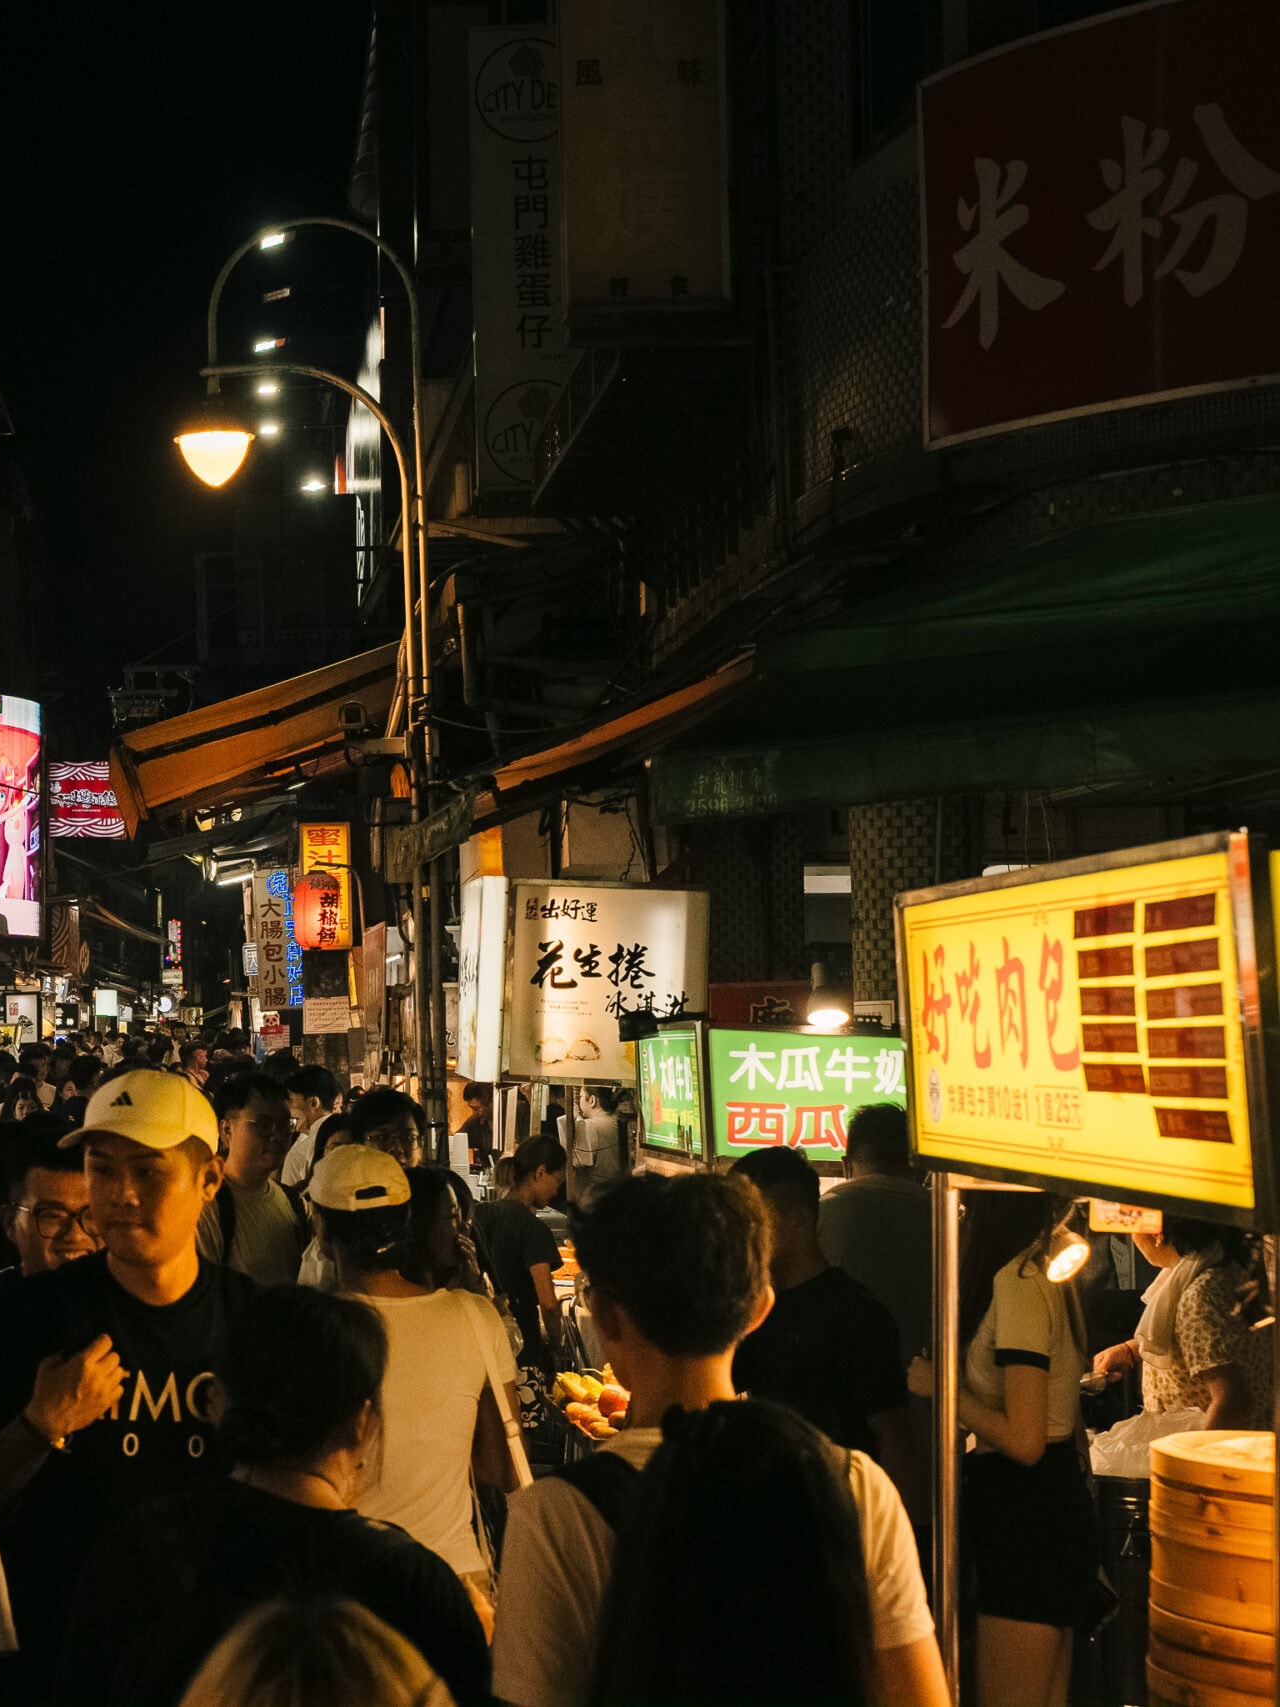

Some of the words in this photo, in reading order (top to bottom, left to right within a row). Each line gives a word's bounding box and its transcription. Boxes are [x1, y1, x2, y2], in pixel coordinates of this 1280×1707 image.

[483, 80, 524, 112] CITY
[942, 102, 1280, 350] 米粉
[512, 156, 553, 349] 屯門雞蛋仔
[492, 421, 534, 452] CITY
[317, 892, 339, 946] 胡椒餅
[540, 898, 598, 923] 出好運
[260, 898, 287, 1007] 大腸包小腸
[530, 940, 656, 990] 花生捲
[922, 933, 1081, 1072] 好吃肉包
[729, 1043, 908, 1094] 木瓜牛奶
